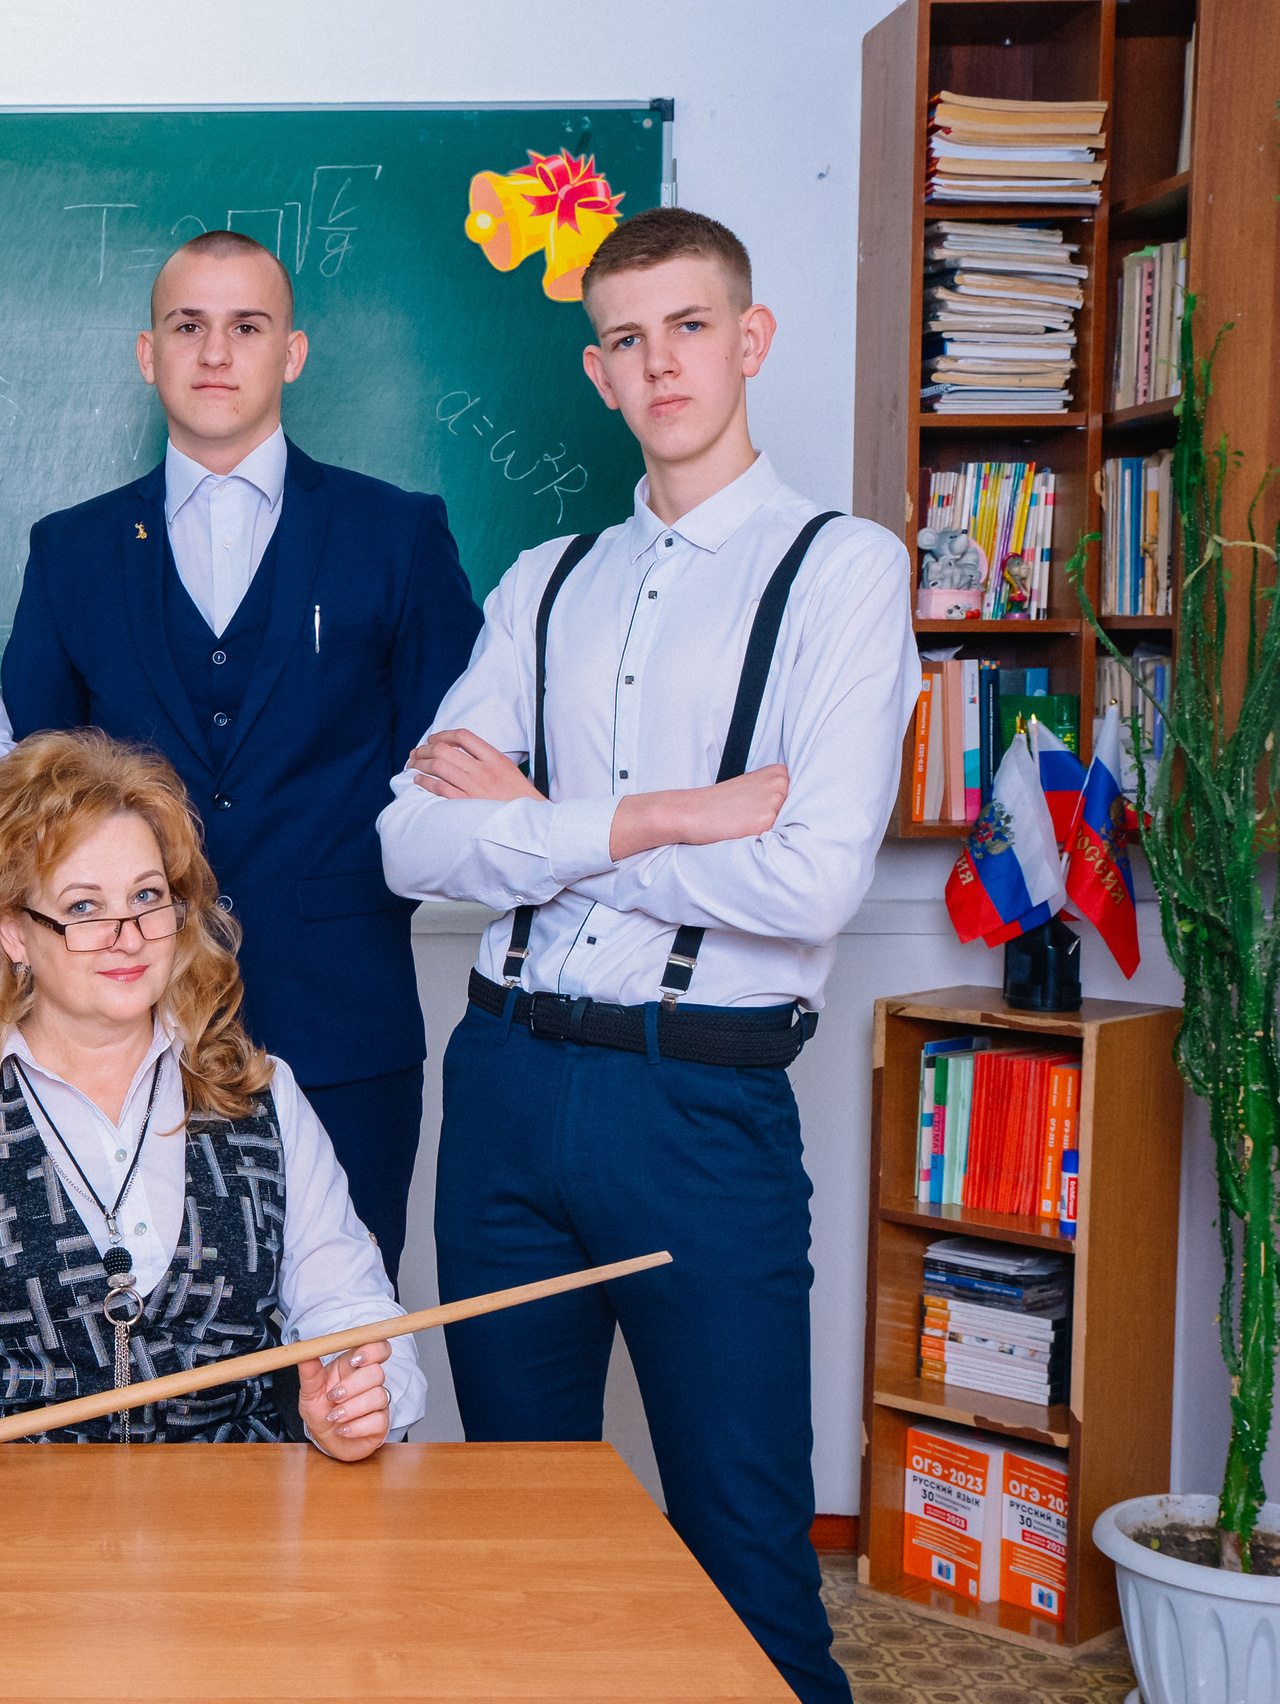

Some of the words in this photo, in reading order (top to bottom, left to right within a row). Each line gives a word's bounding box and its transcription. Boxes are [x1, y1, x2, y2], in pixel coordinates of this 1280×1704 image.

[1076, 829, 1126, 906] ОССИЯ
[931, 1093, 941, 1169] ХРЕСТОМАТИЯ
[912, 1455, 984, 1492] ОГЭ-2023
[913, 1475, 953, 1496] РУССКИЙ
[956, 1492, 981, 1507] ЯЗЫК
[921, 1489, 934, 1502] 30
[947, 1513, 965, 1528] 2023
[1009, 1500, 1052, 1522] РУССКИЙ
[1019, 1515, 1032, 1528] 30
